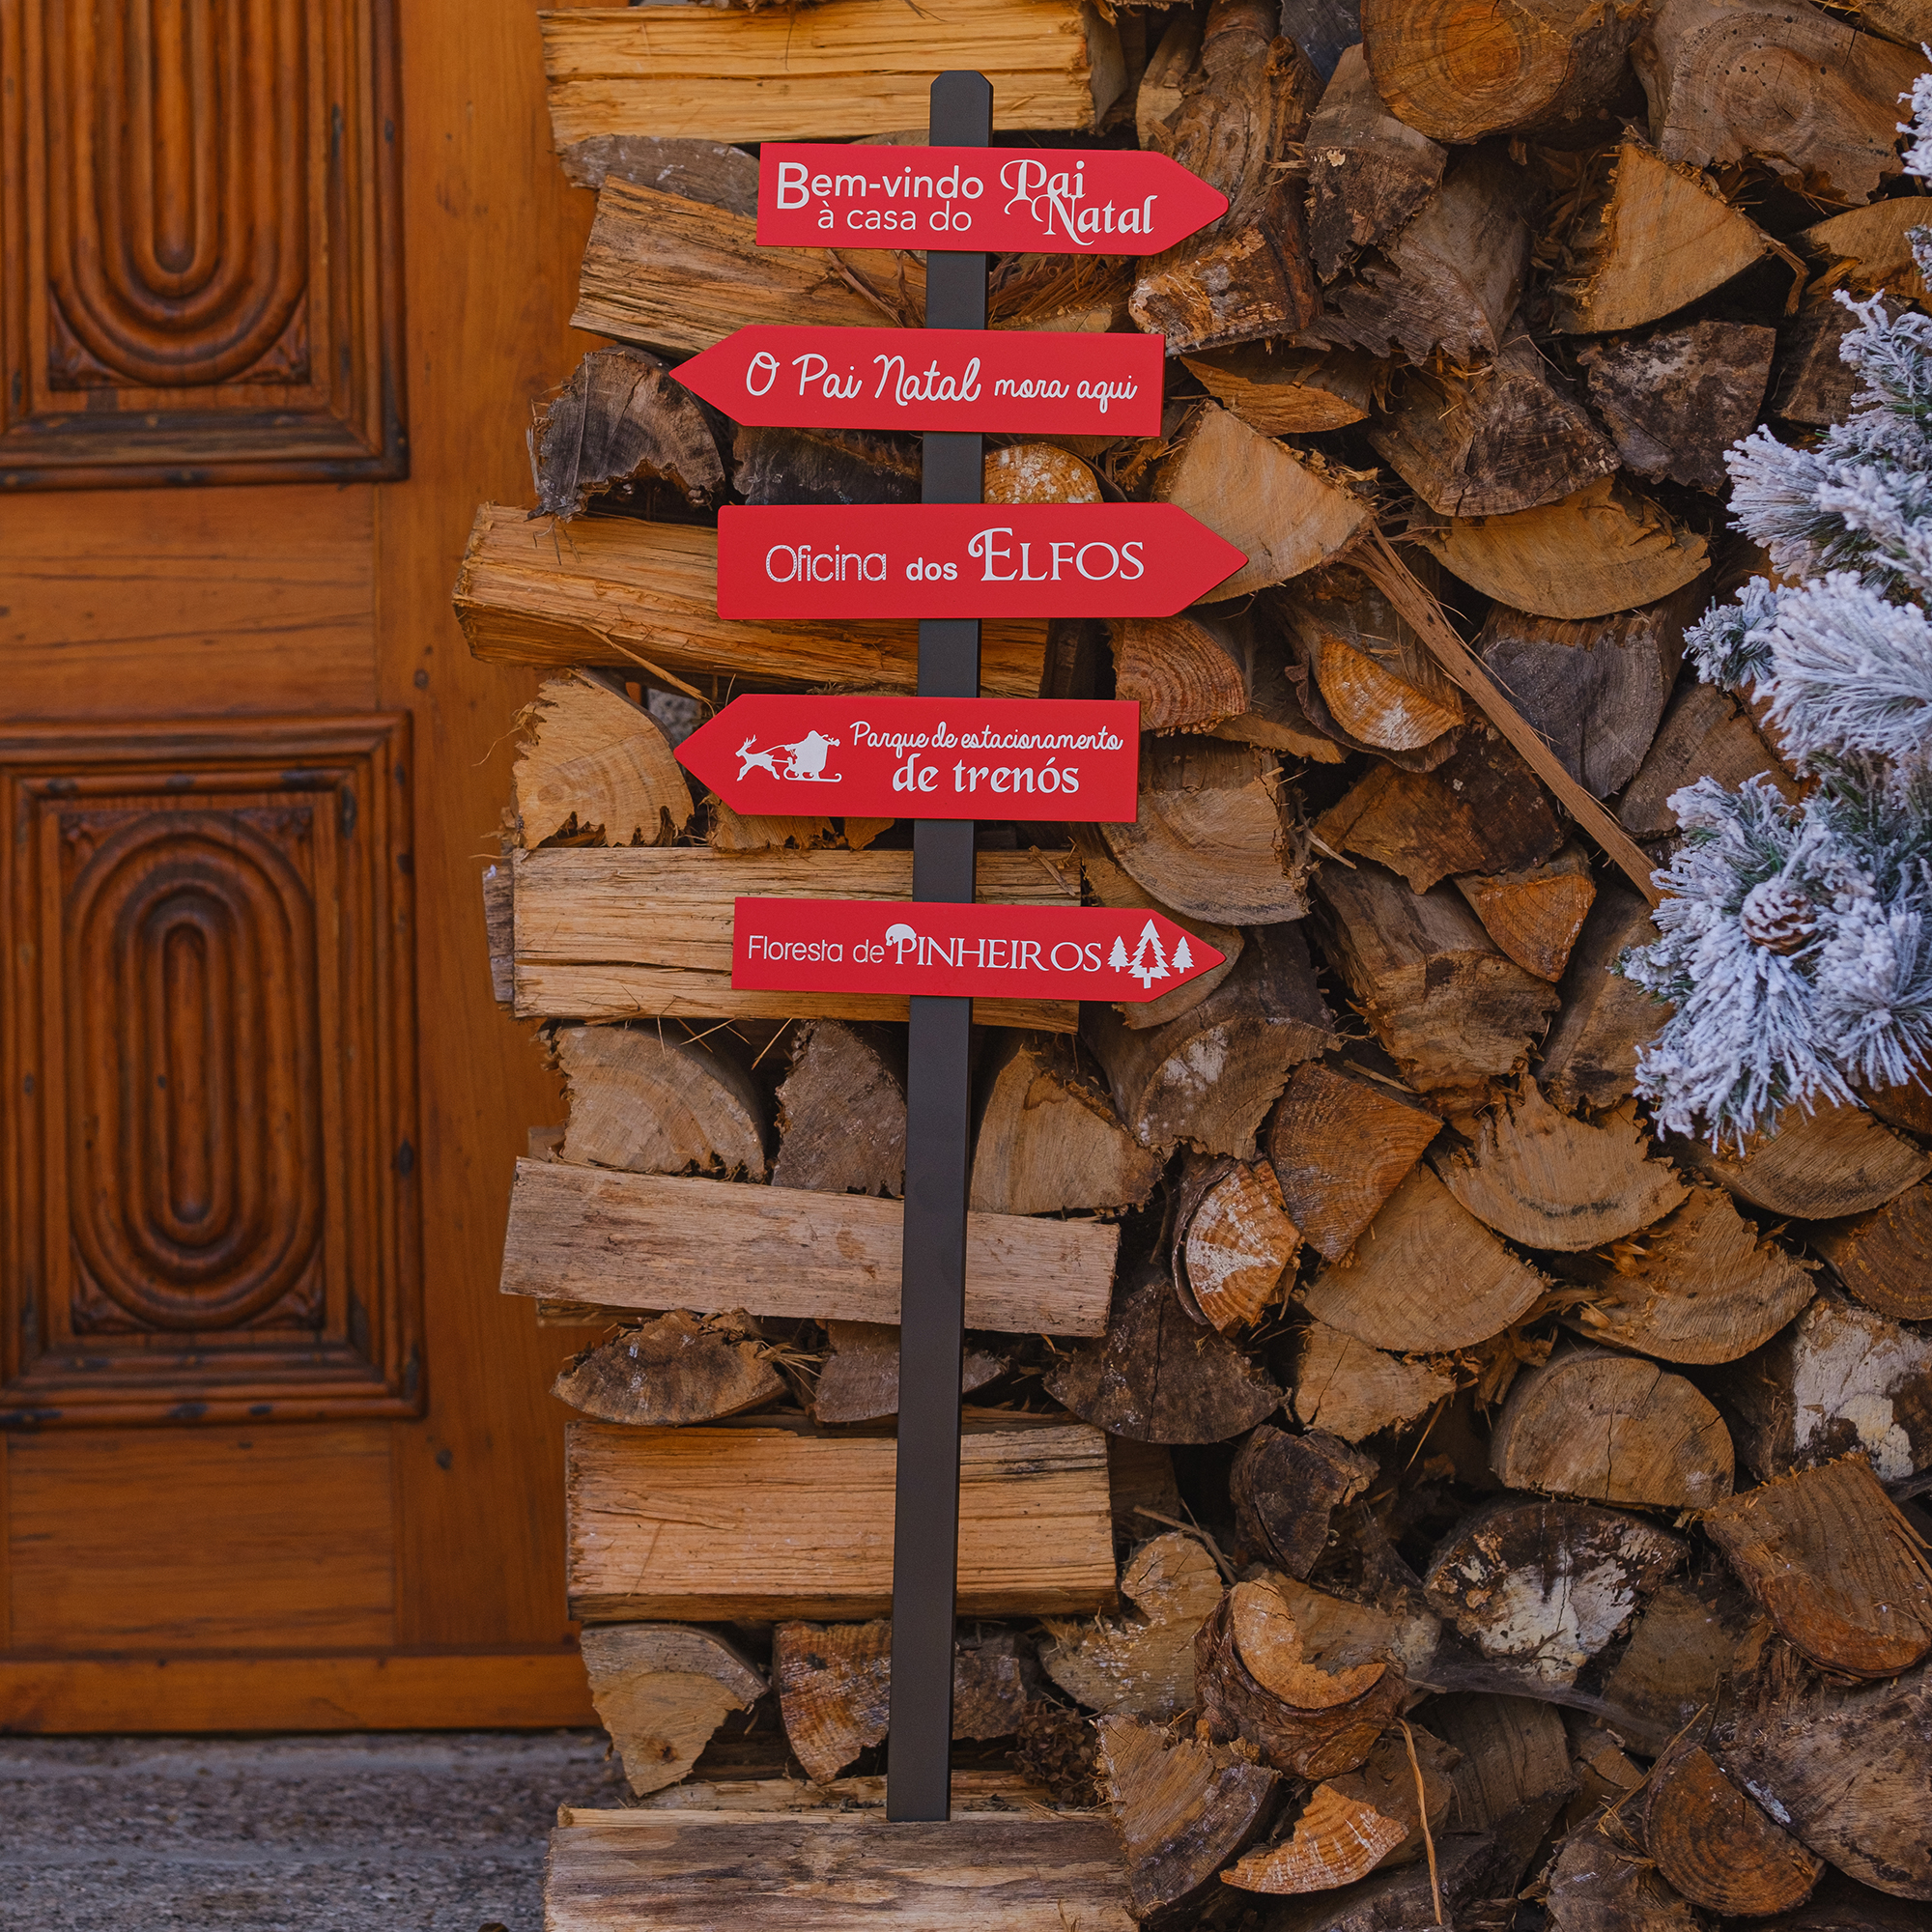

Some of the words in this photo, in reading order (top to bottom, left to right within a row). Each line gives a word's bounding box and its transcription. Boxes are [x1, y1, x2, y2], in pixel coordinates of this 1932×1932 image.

[777, 161, 984, 210] Bem-vindo
[1000, 159, 1086, 214] Pai
[817, 200, 834, 229] à
[846, 210, 917, 231] casa
[928, 200, 972, 232] do
[1030, 193, 1158, 246] Natal
[746, 351, 781, 396] O
[791, 353, 864, 399] Pai
[872, 354, 981, 407] Natal
[994, 378, 1070, 399] mora
[1076, 374, 1138, 413] aqui
[765, 544, 887, 582] Oficina
[905, 556, 958, 582] dos
[967, 527, 1145, 582] ELFOS
[849, 721, 930, 759] Parque
[930, 721, 960, 749] de
[960, 724, 1124, 752] estacionamento
[892, 753, 939, 792] de
[952, 756, 1080, 794] trenós
[748, 935, 844, 962] Floresta
[852, 939, 885, 964] de
[893, 931, 1102, 972] PINHEIROS
